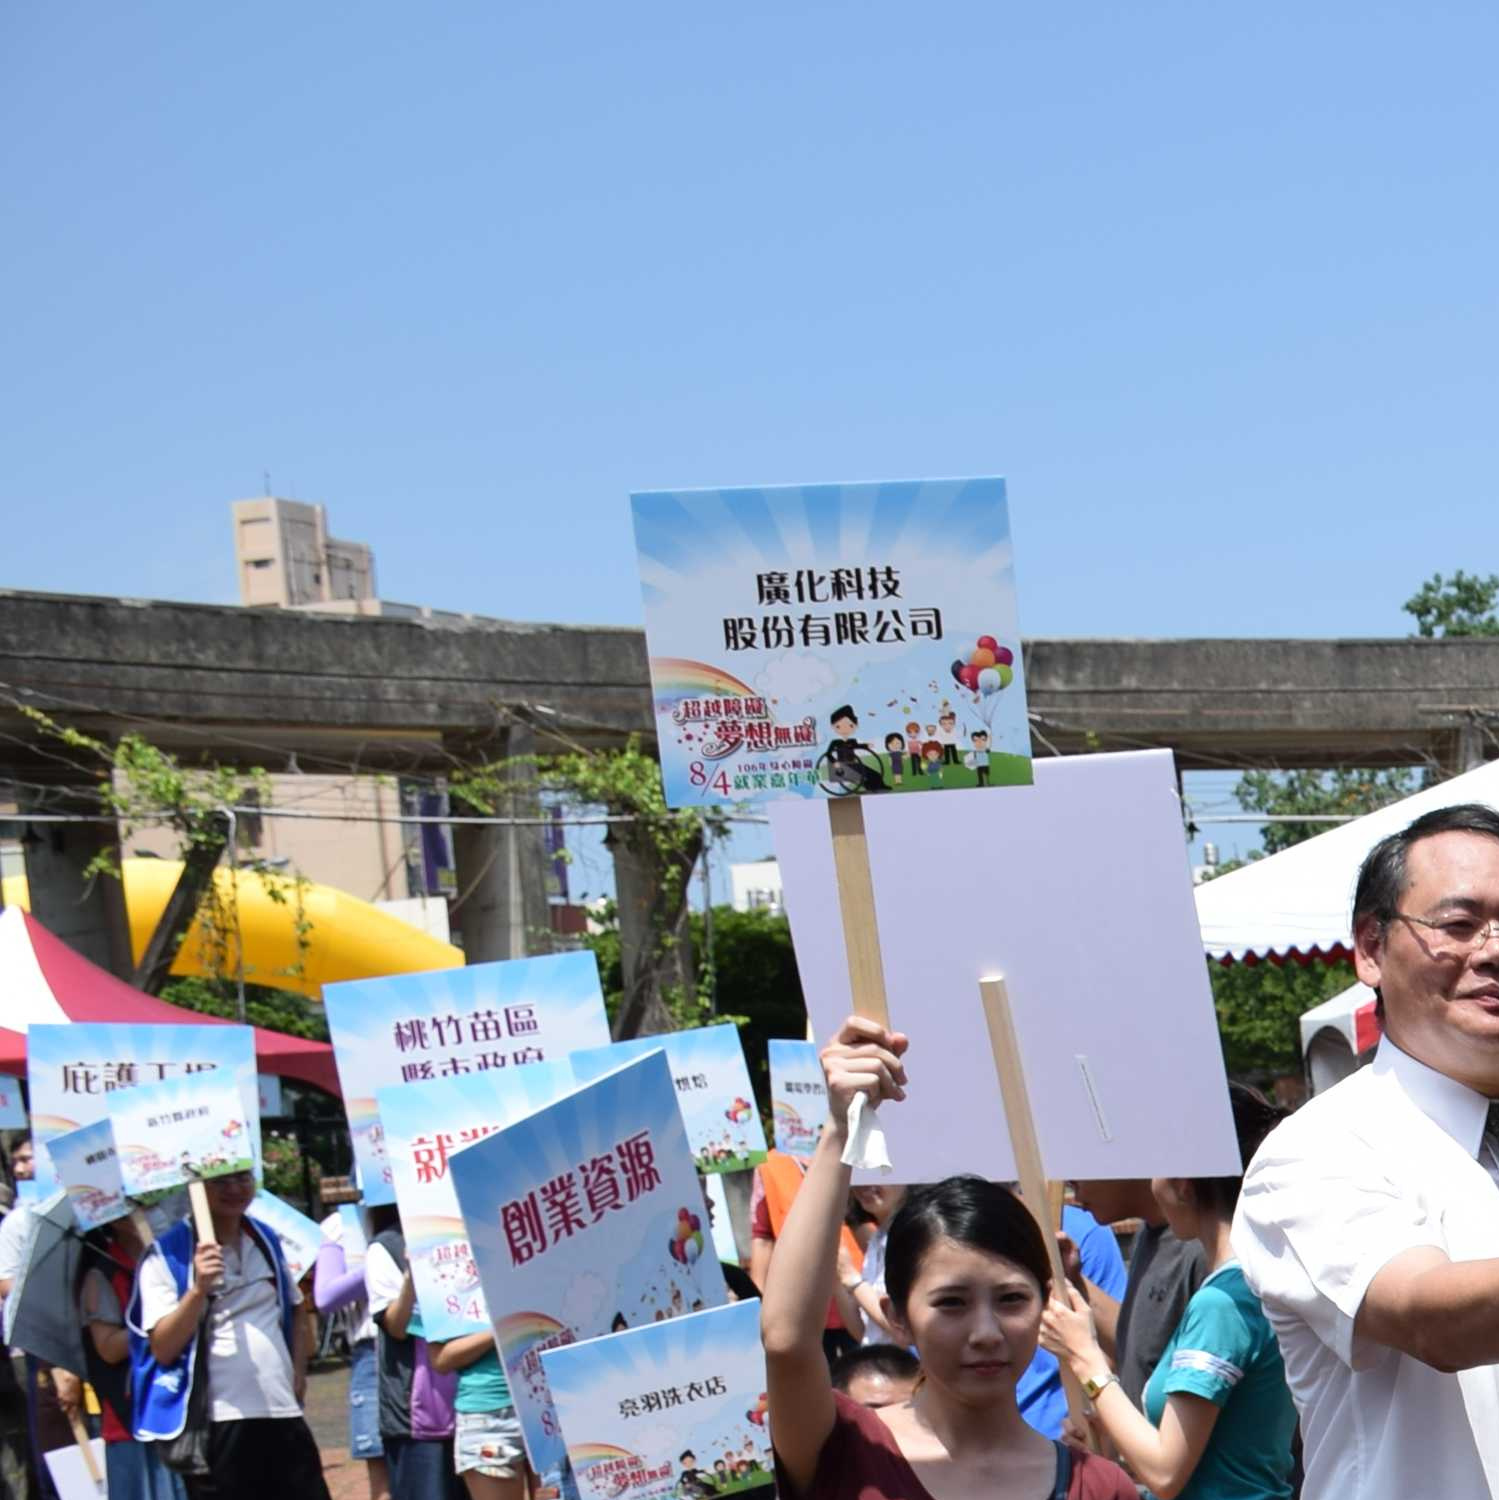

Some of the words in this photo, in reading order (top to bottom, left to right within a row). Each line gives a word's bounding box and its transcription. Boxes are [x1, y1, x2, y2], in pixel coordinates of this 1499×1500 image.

[756, 565, 902, 606] 廣化科技
[723, 607, 943, 650] 股份有限公司
[690, 761, 731, 796] 8/4
[393, 1003, 541, 1052] 桃竹苗區
[501, 1131, 662, 1269] 創業資源
[619, 1375, 727, 1419] 亮羽洗衣店
